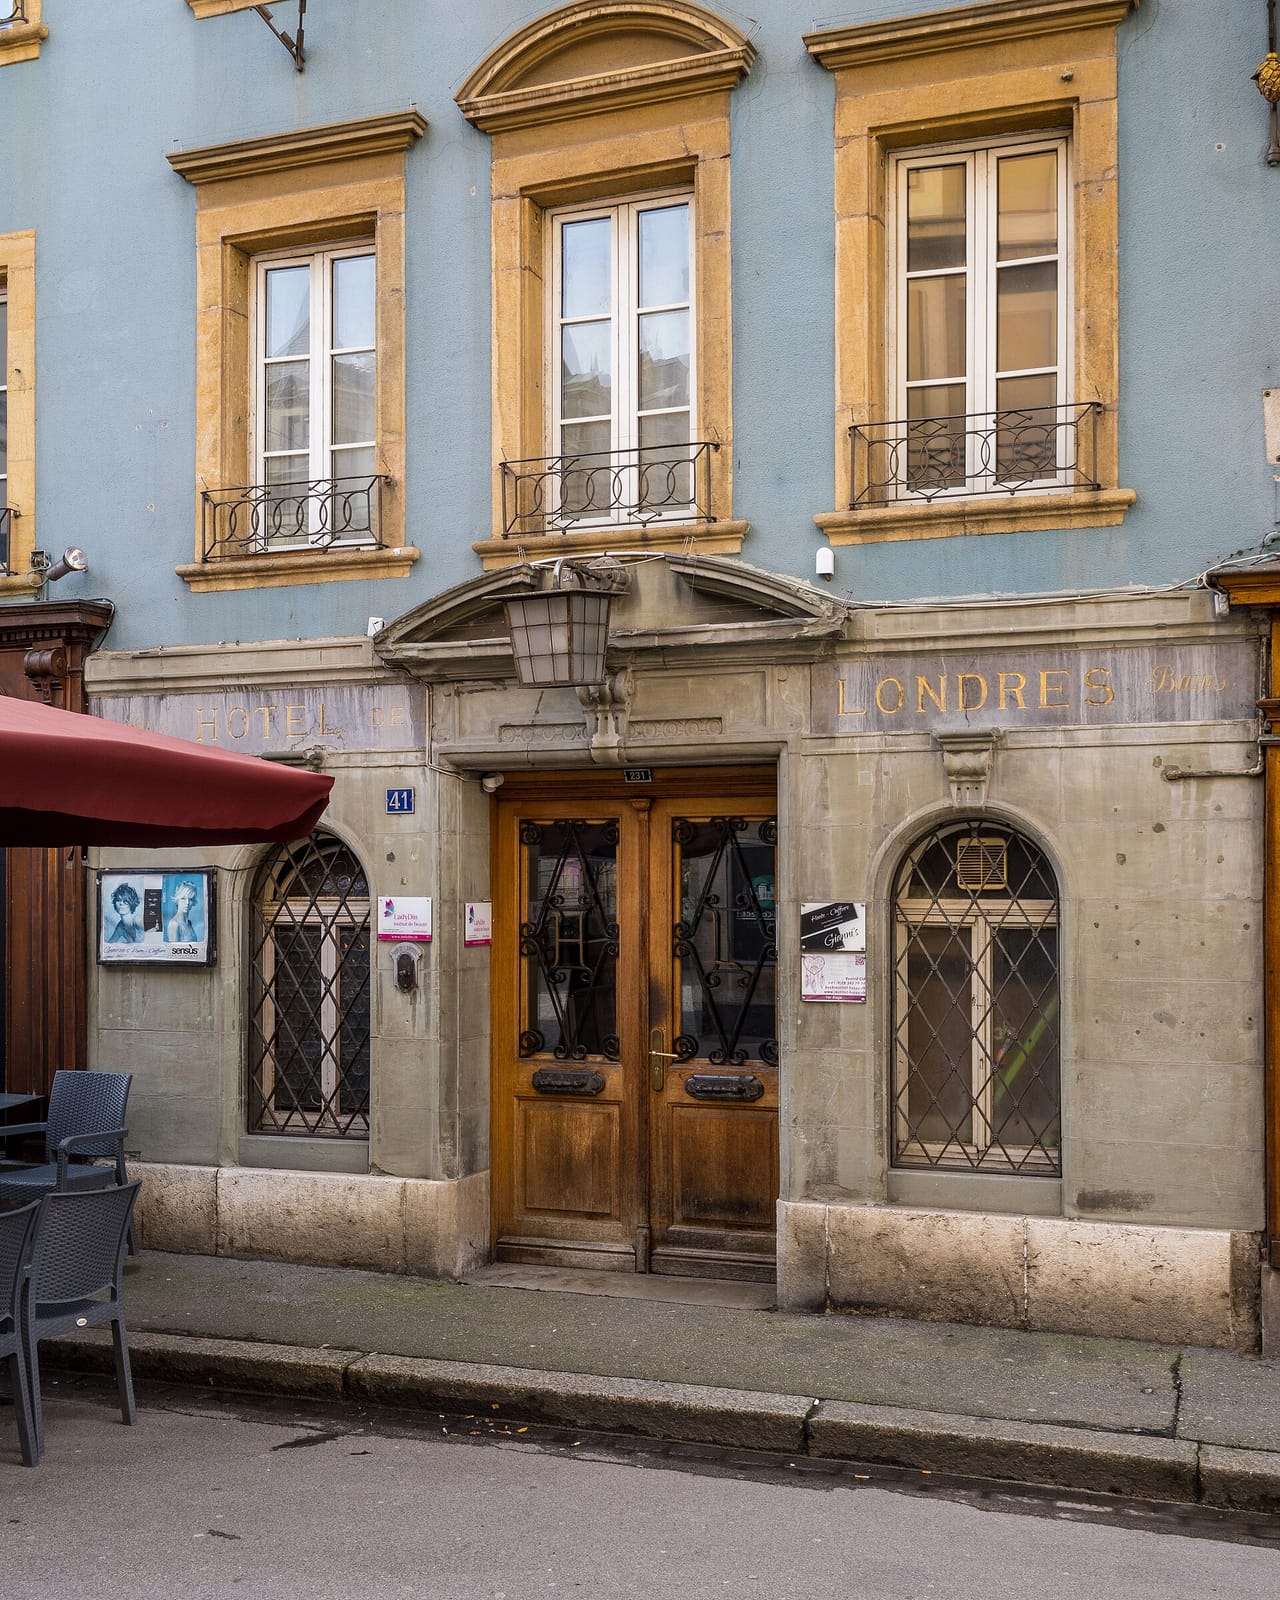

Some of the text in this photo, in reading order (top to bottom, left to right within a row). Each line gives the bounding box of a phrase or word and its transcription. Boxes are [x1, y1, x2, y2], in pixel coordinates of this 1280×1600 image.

[837, 667, 1115, 716] LONDRES
[196, 703, 338, 741] HOTEL
[370, 706, 405, 727] DE
[629, 771, 646, 780] 231
[389, 791, 408, 810] 41
